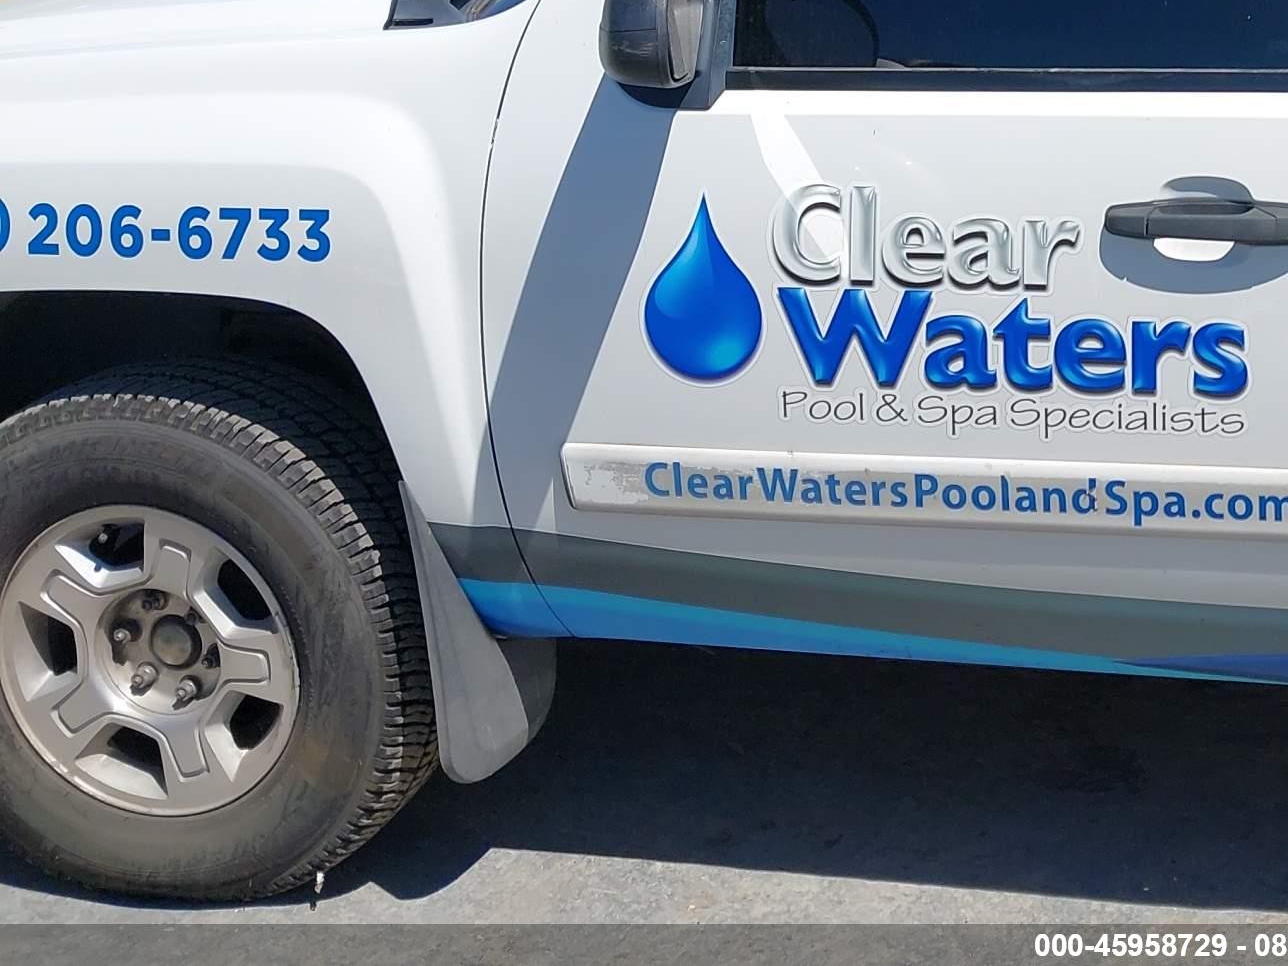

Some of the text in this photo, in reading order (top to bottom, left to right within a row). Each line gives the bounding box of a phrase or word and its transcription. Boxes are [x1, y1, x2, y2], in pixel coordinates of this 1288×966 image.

[27, 202, 331, 262] 206-6733
[771, 183, 1079, 289] Clear
[776, 286, 1249, 398] Waters
[781, 391, 1246, 439] Pool & Spa Specialists
